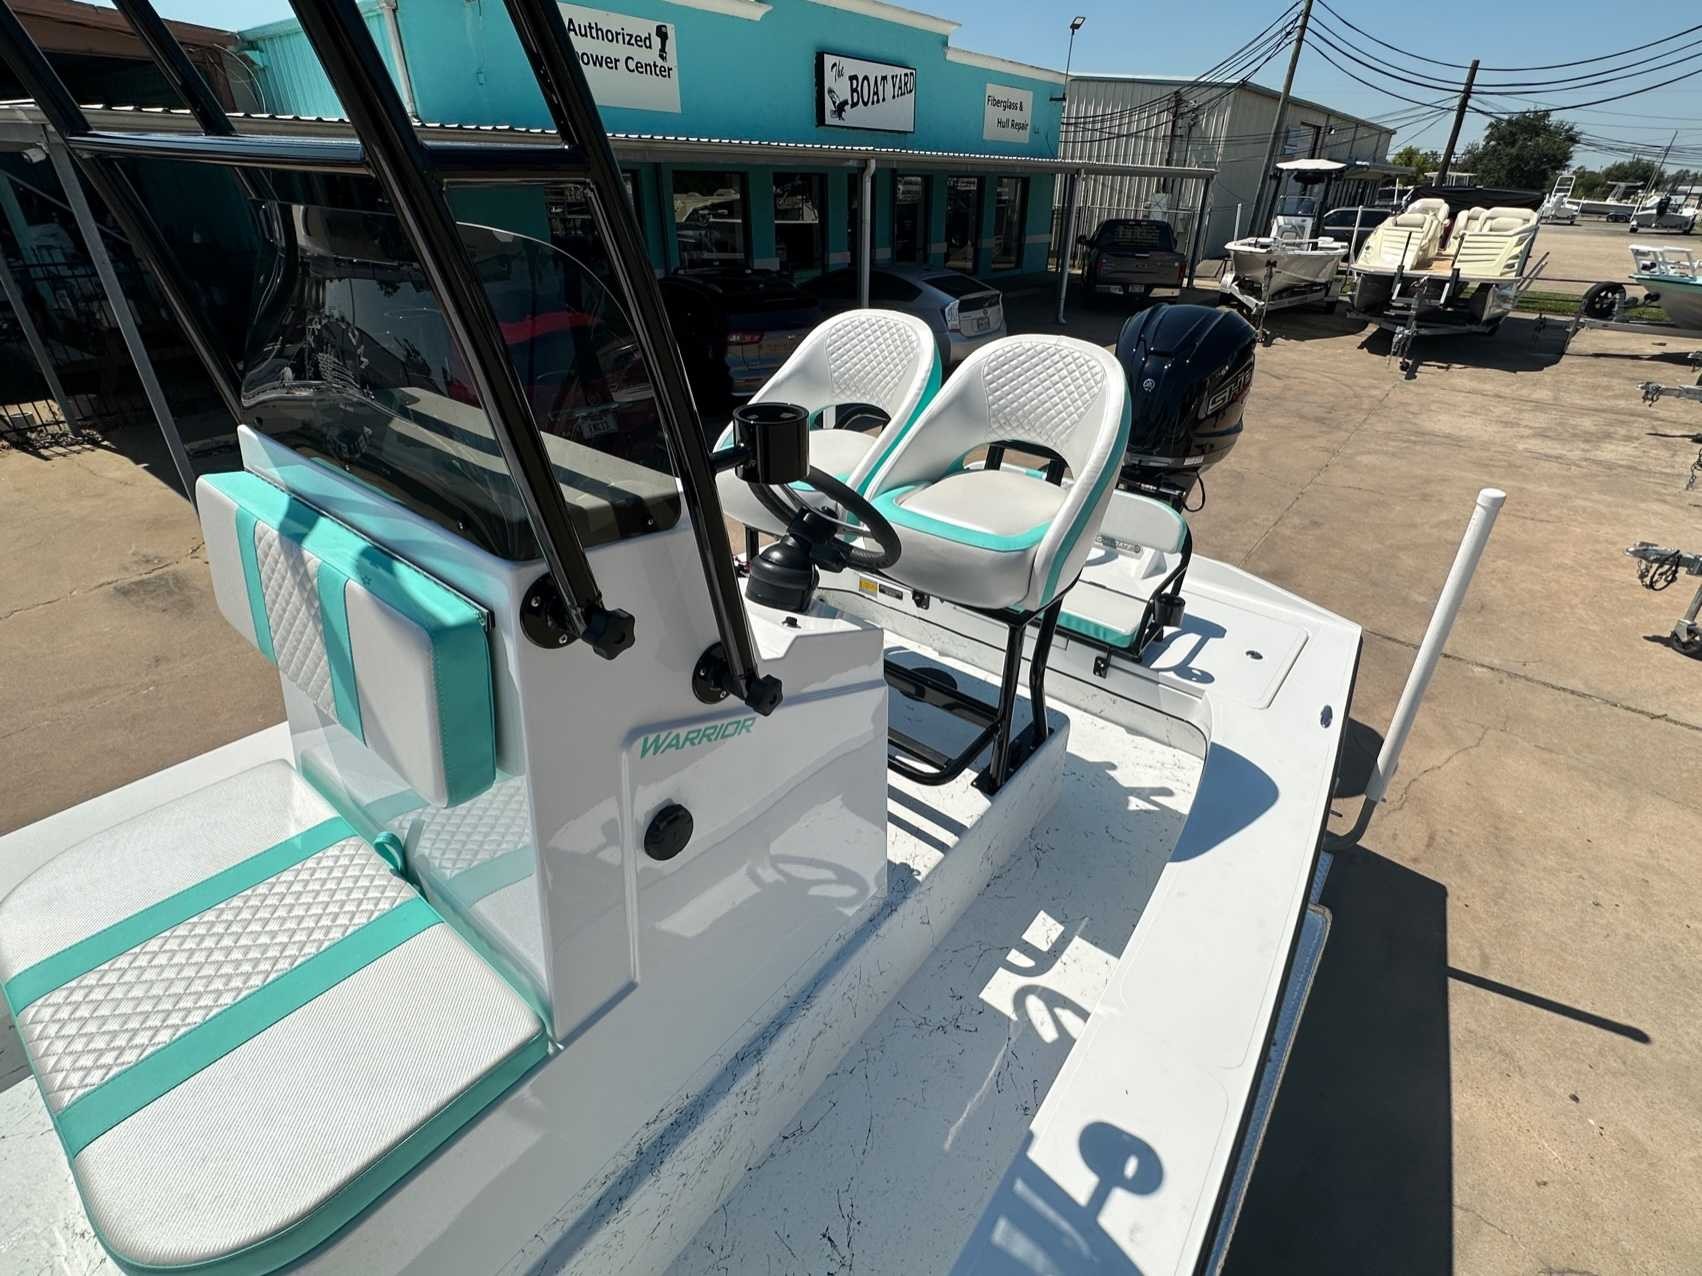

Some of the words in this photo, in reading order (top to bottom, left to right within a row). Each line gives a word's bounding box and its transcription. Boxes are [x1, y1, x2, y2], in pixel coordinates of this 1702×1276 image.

[567, 17, 653, 50] Authorized
[576, 51, 620, 71] ower
[624, 56, 673, 79] Center
[831, 60, 844, 82] The
[848, 73, 888, 109] BOAT
[891, 71, 915, 100] YARD
[987, 95, 1019, 111] Fiberglass
[1019, 101, 1024, 112] &
[996, 117, 1010, 129] Hull
[1010, 119, 1029, 133] Repair
[640, 716, 757, 760] WARRIOR
